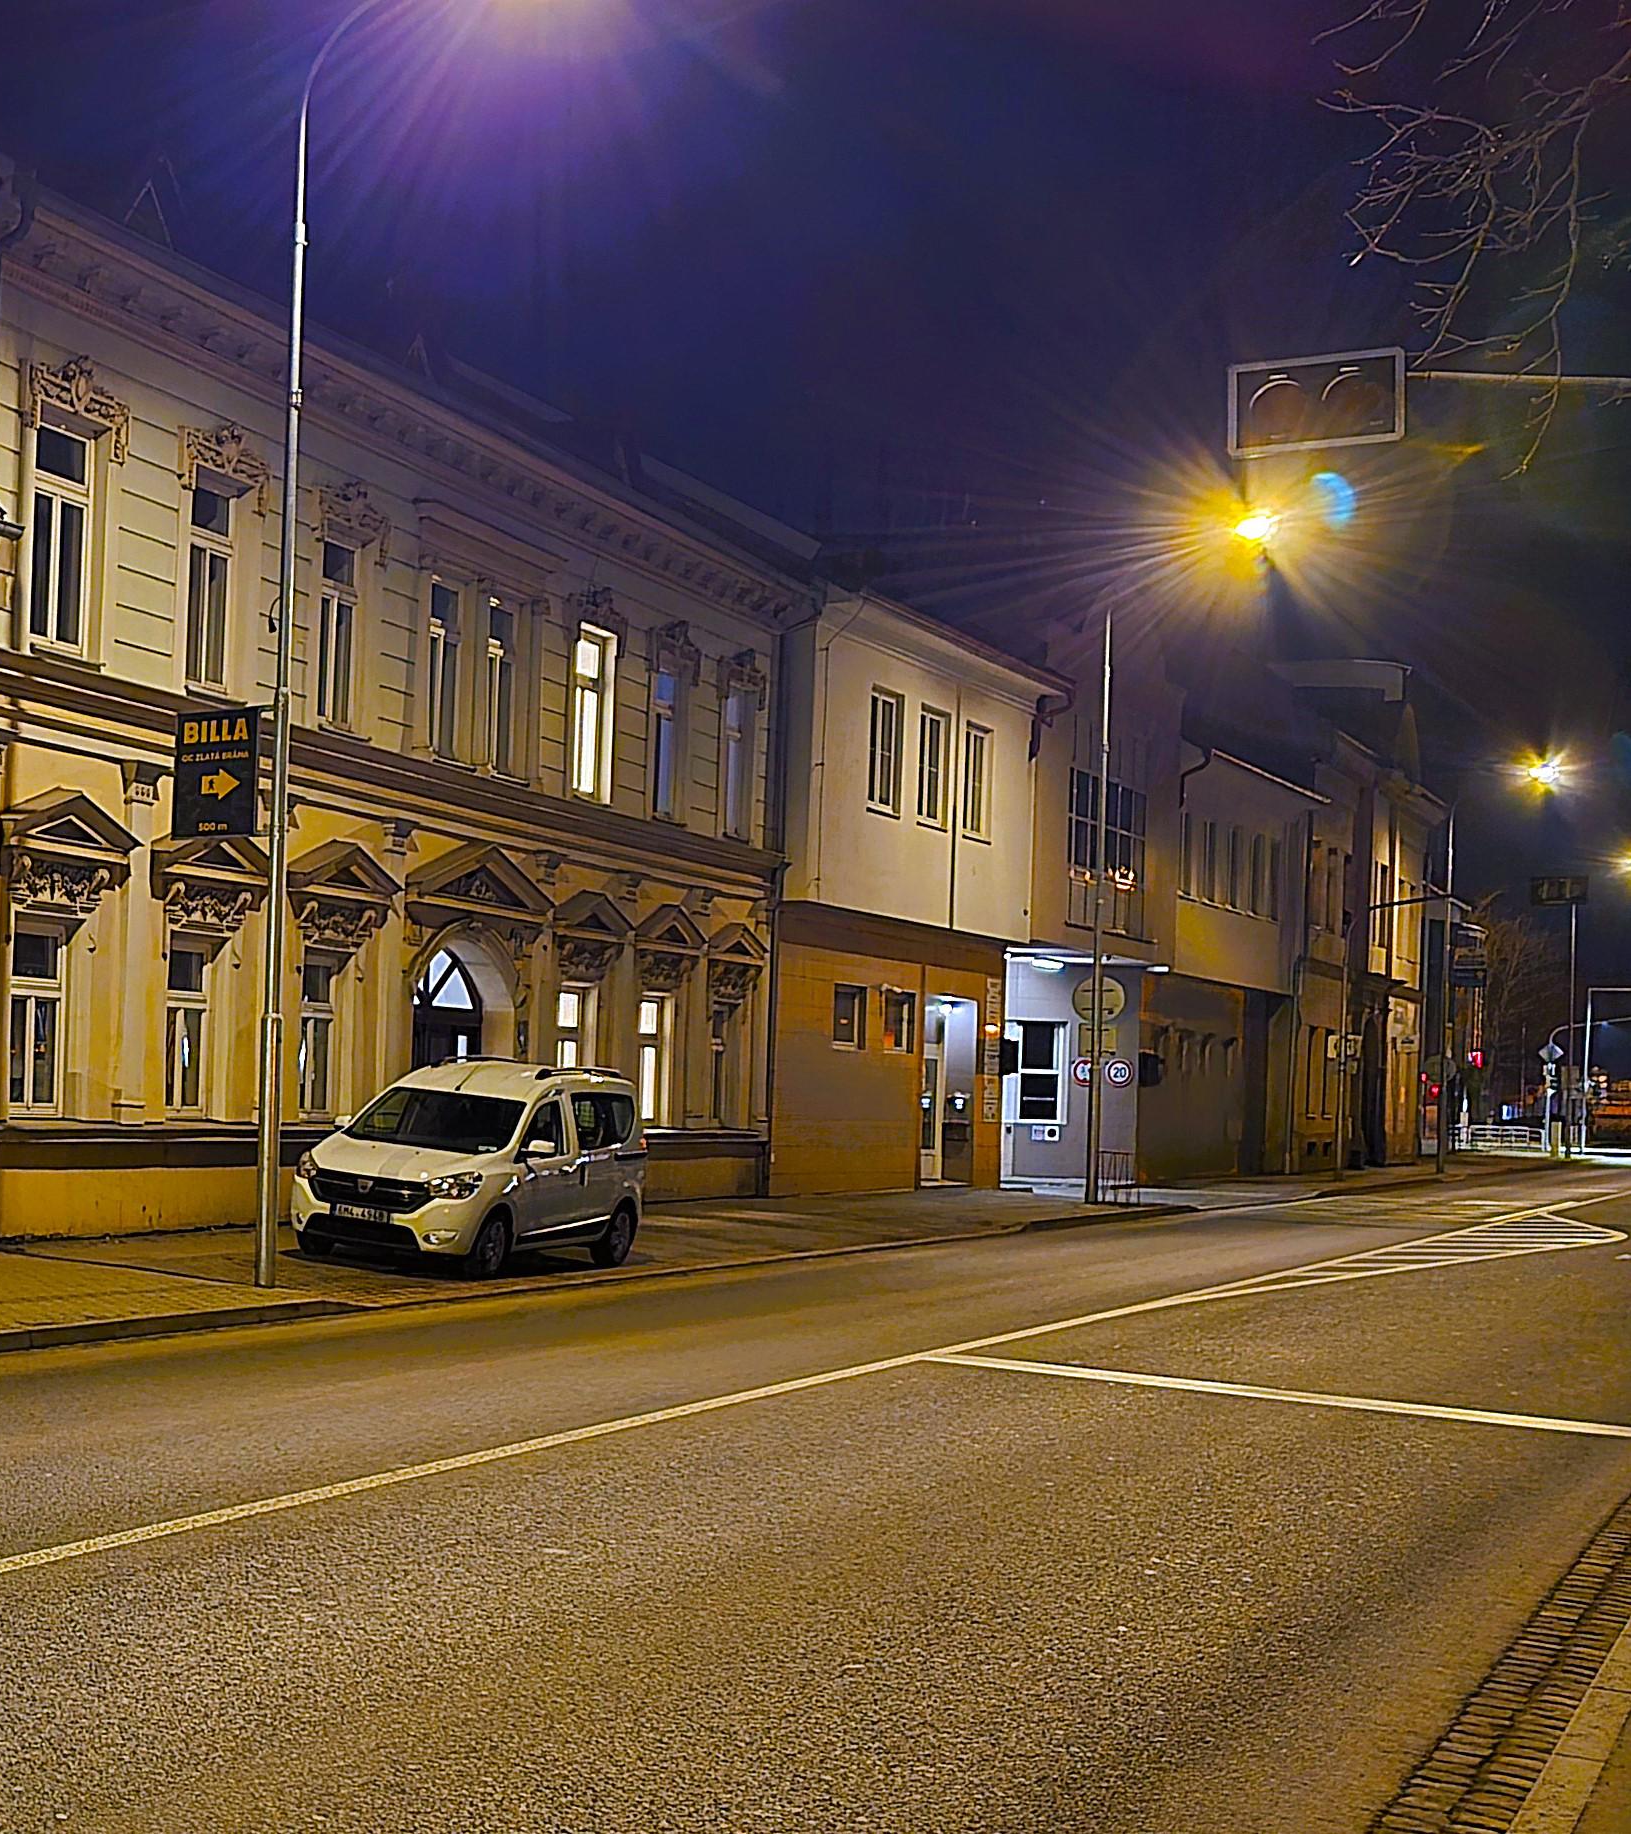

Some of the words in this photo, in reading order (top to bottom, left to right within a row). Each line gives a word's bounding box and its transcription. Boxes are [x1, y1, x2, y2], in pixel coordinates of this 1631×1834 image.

[183, 717, 249, 744] BILLA
[198, 822, 216, 832] 500
[1112, 1066, 1127, 1078] 20
